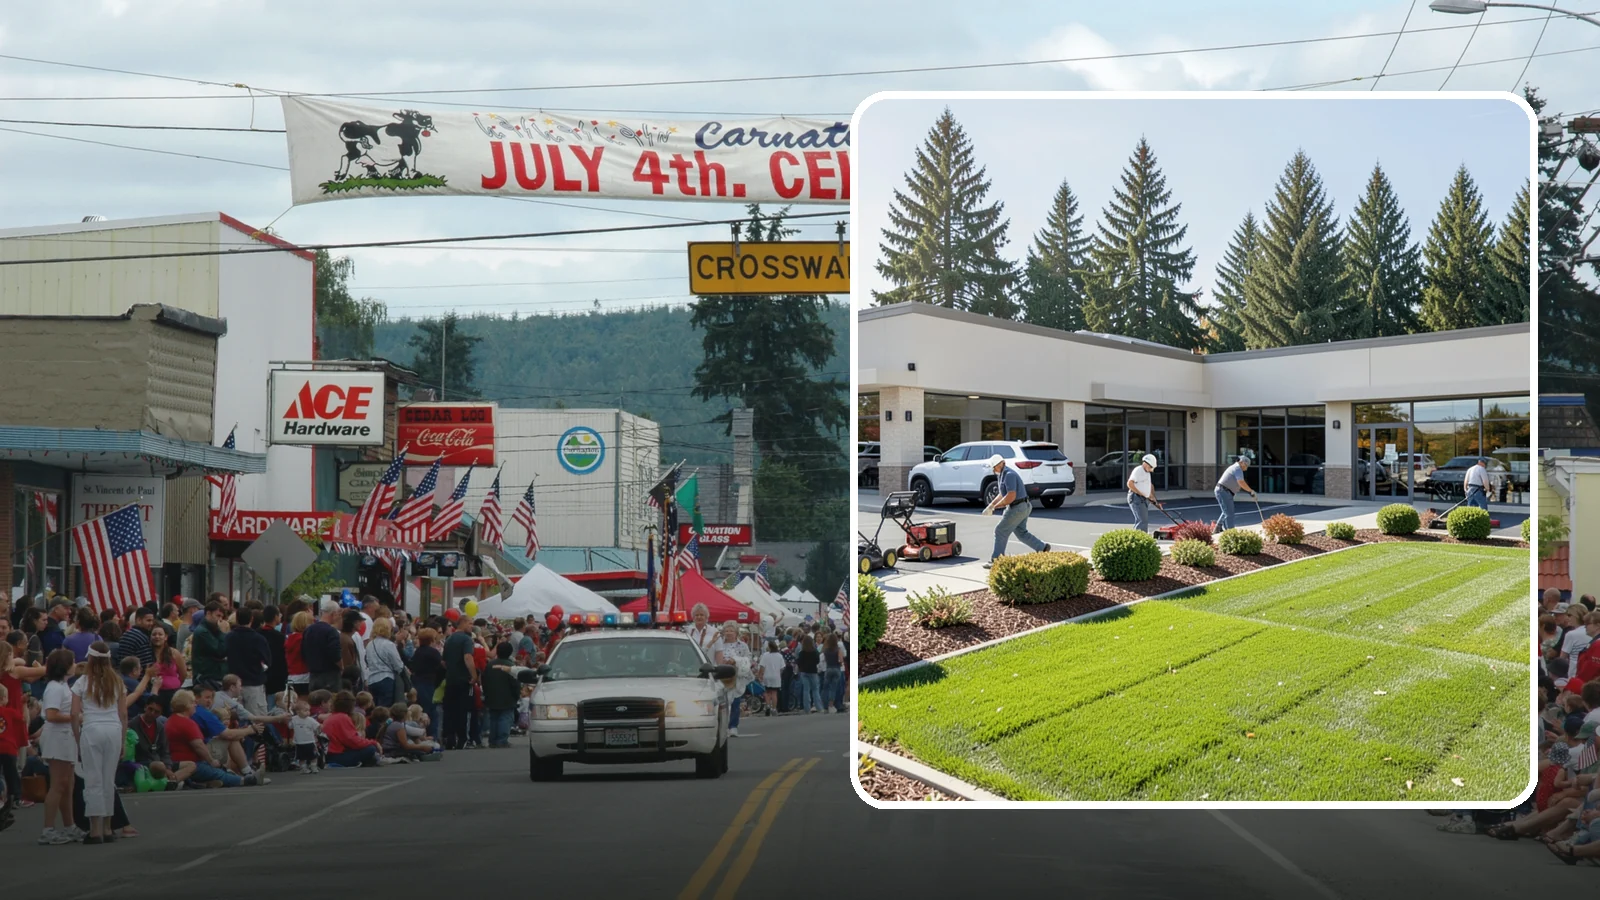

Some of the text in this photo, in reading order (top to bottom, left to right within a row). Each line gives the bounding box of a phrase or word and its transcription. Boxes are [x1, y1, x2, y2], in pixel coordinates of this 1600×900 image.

[481, 141, 605, 192] JULY
[632, 150, 746, 198] 4th.
[696, 254, 850, 280] CROSSWA
[282, 380, 374, 420] ACE
[405, 408, 453, 422] CEDAR
[283, 421, 371, 437] Hardware
[95, 485, 124, 495] Vincent
[126, 486, 136, 495] de
[137, 486, 155, 495] Paul
[688, 526, 741, 535] CRNATION
[699, 535, 730, 543] GLASS
